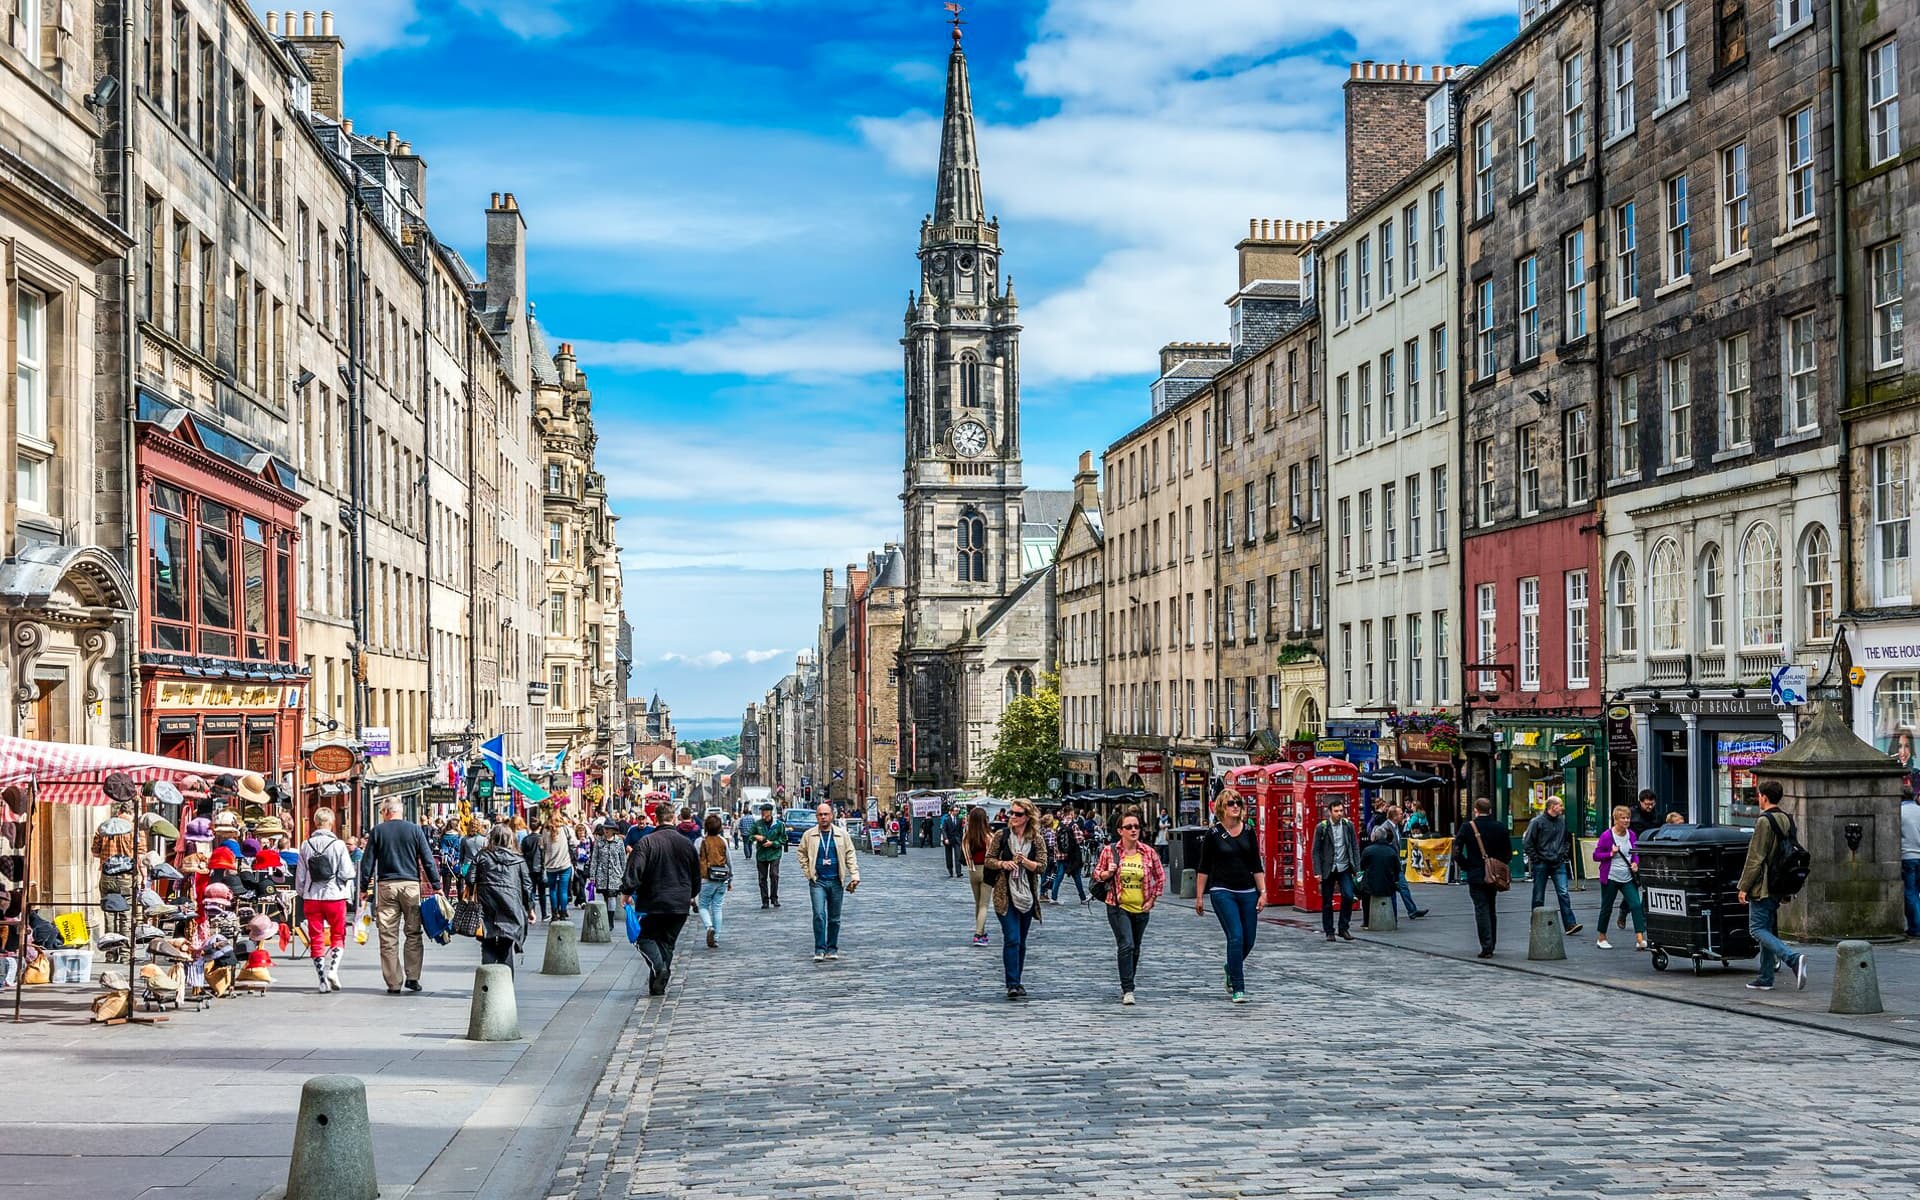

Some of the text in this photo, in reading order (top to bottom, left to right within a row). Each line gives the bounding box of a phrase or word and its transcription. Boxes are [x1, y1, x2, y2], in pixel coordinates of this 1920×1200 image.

[1865, 647, 1880, 659] THE
[1881, 646, 1899, 658] WEE
[1669, 701, 1686, 713] BAY
[1692, 700, 1703, 712] OF
[1710, 700, 1750, 713] BENGAL
[1717, 741, 1733, 752] BAY
[1651, 891, 1683, 911] LITTER
